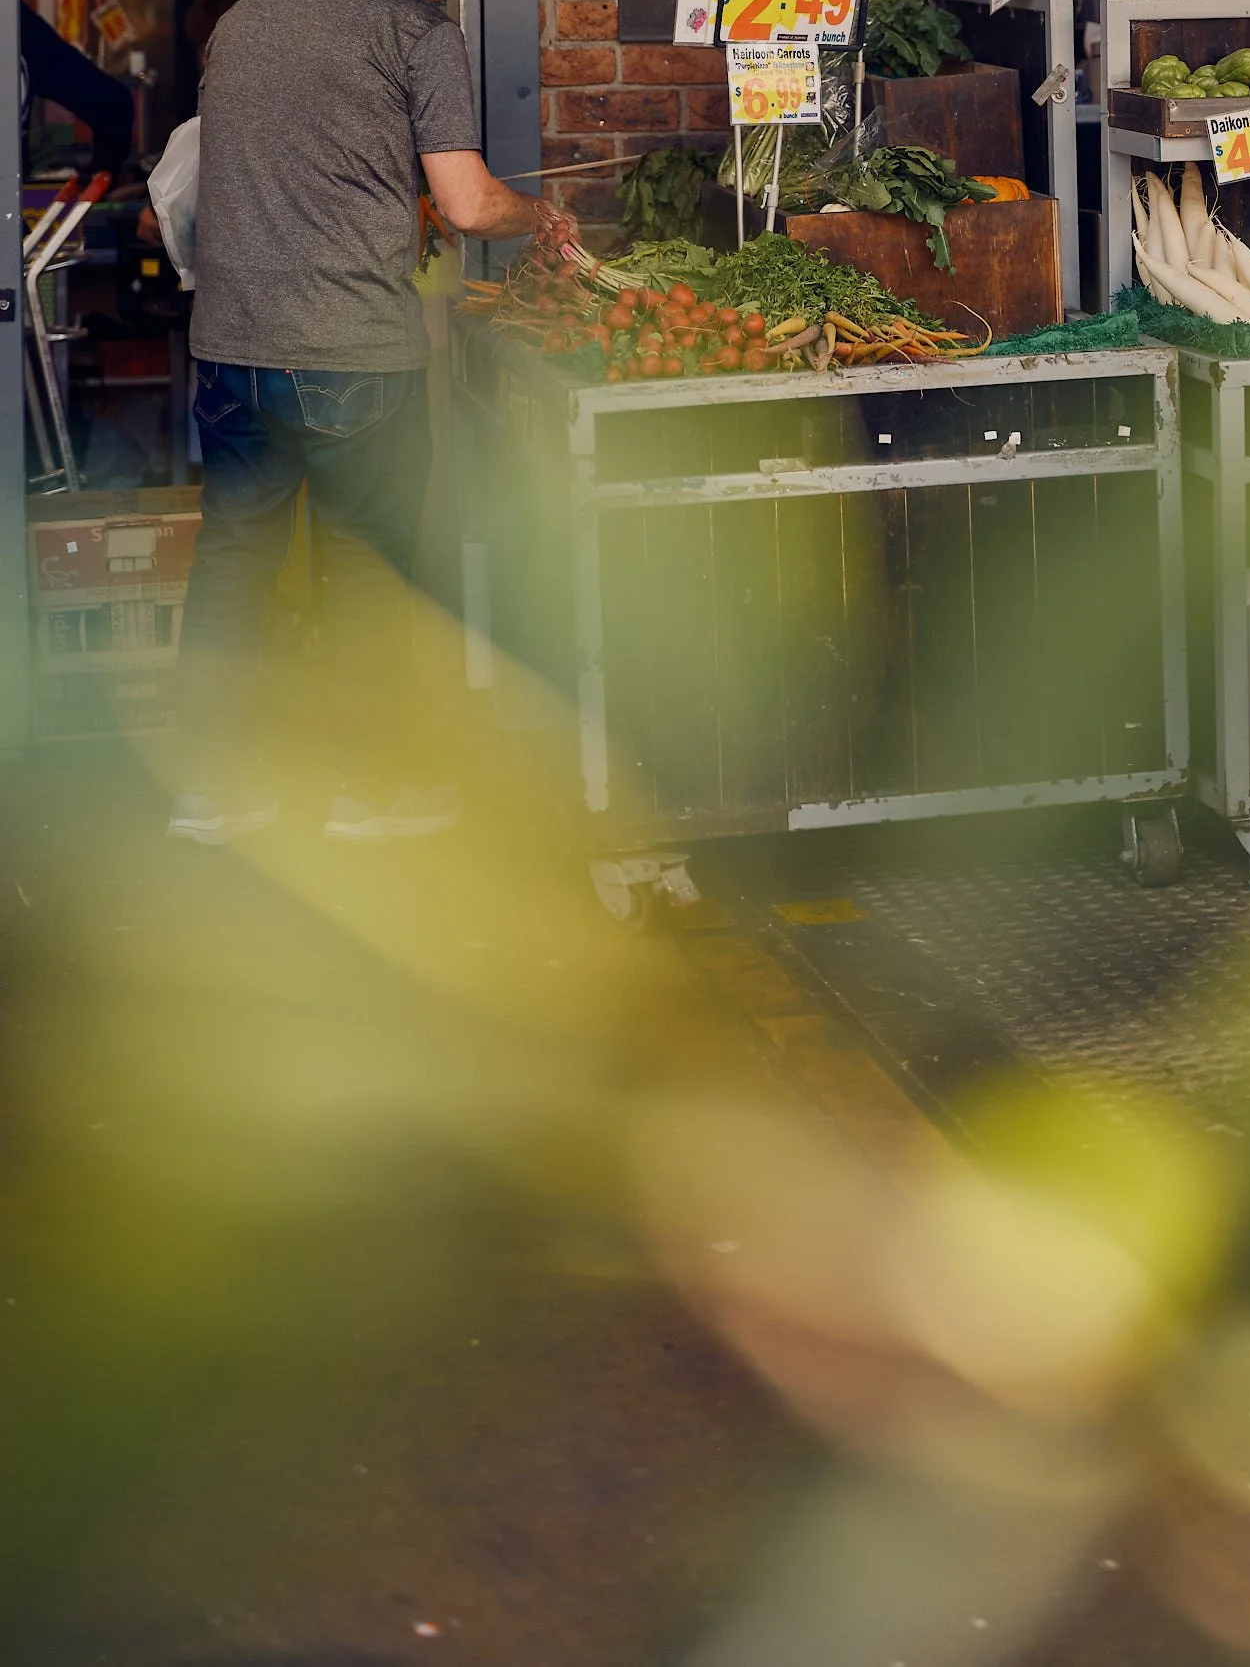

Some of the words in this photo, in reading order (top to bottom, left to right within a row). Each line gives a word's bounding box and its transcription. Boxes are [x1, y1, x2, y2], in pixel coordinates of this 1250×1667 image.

[814, 33, 821, 42] a
[821, 31, 846, 43] bunch
[732, 48, 774, 60] Heirloom
[777, 48, 811, 59] Carrots
[1210, 115, 1250, 135] Daikon
